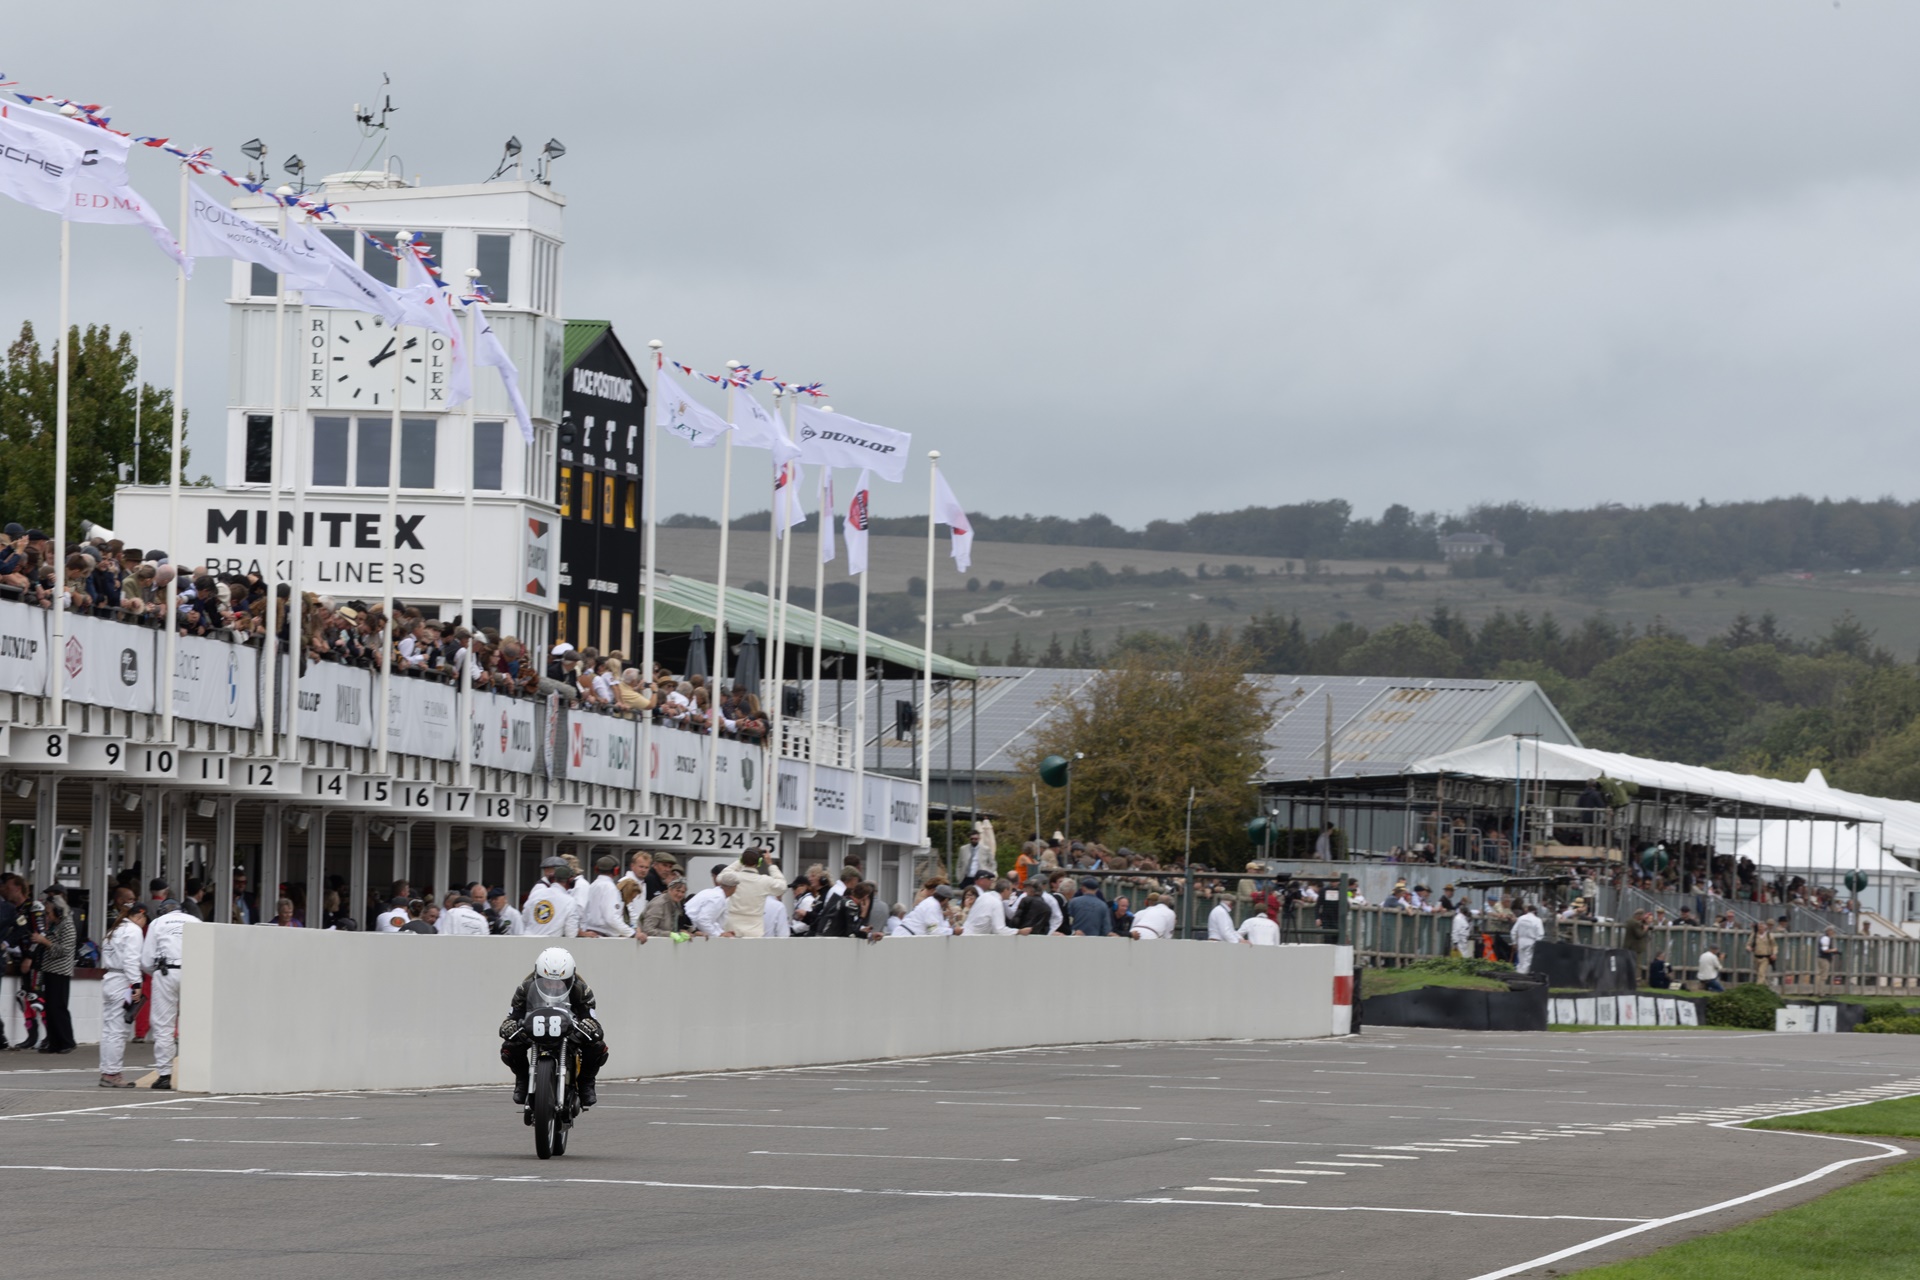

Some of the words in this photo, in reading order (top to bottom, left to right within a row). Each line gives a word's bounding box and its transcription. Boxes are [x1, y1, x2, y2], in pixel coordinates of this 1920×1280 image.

[310, 319, 324, 398] ROLEX
[430, 331, 444, 400] OLEX
[820, 430, 896, 454] DUNLOP
[206, 508, 426, 550] MINTEX
[318, 561, 425, 585] LINERS
[47, 734, 61, 757] 8
[105, 743, 120, 765] 9
[146, 750, 173, 773] 10
[202, 757, 224, 779] 11
[248, 764, 273, 786] 12
[317, 774, 342, 795] 14
[364, 781, 387, 802] 15
[405, 787, 429, 807] 16
[447, 791, 470, 811] 17
[487, 798, 510, 818] 18
[526, 804, 549, 823] 19
[590, 813, 616, 832] 20
[628, 819, 650, 837] 21
[658, 823, 683, 841] 22
[692, 828, 715, 846] 23
[720, 831, 745, 849] 24
[532, 1015, 562, 1037] 68
